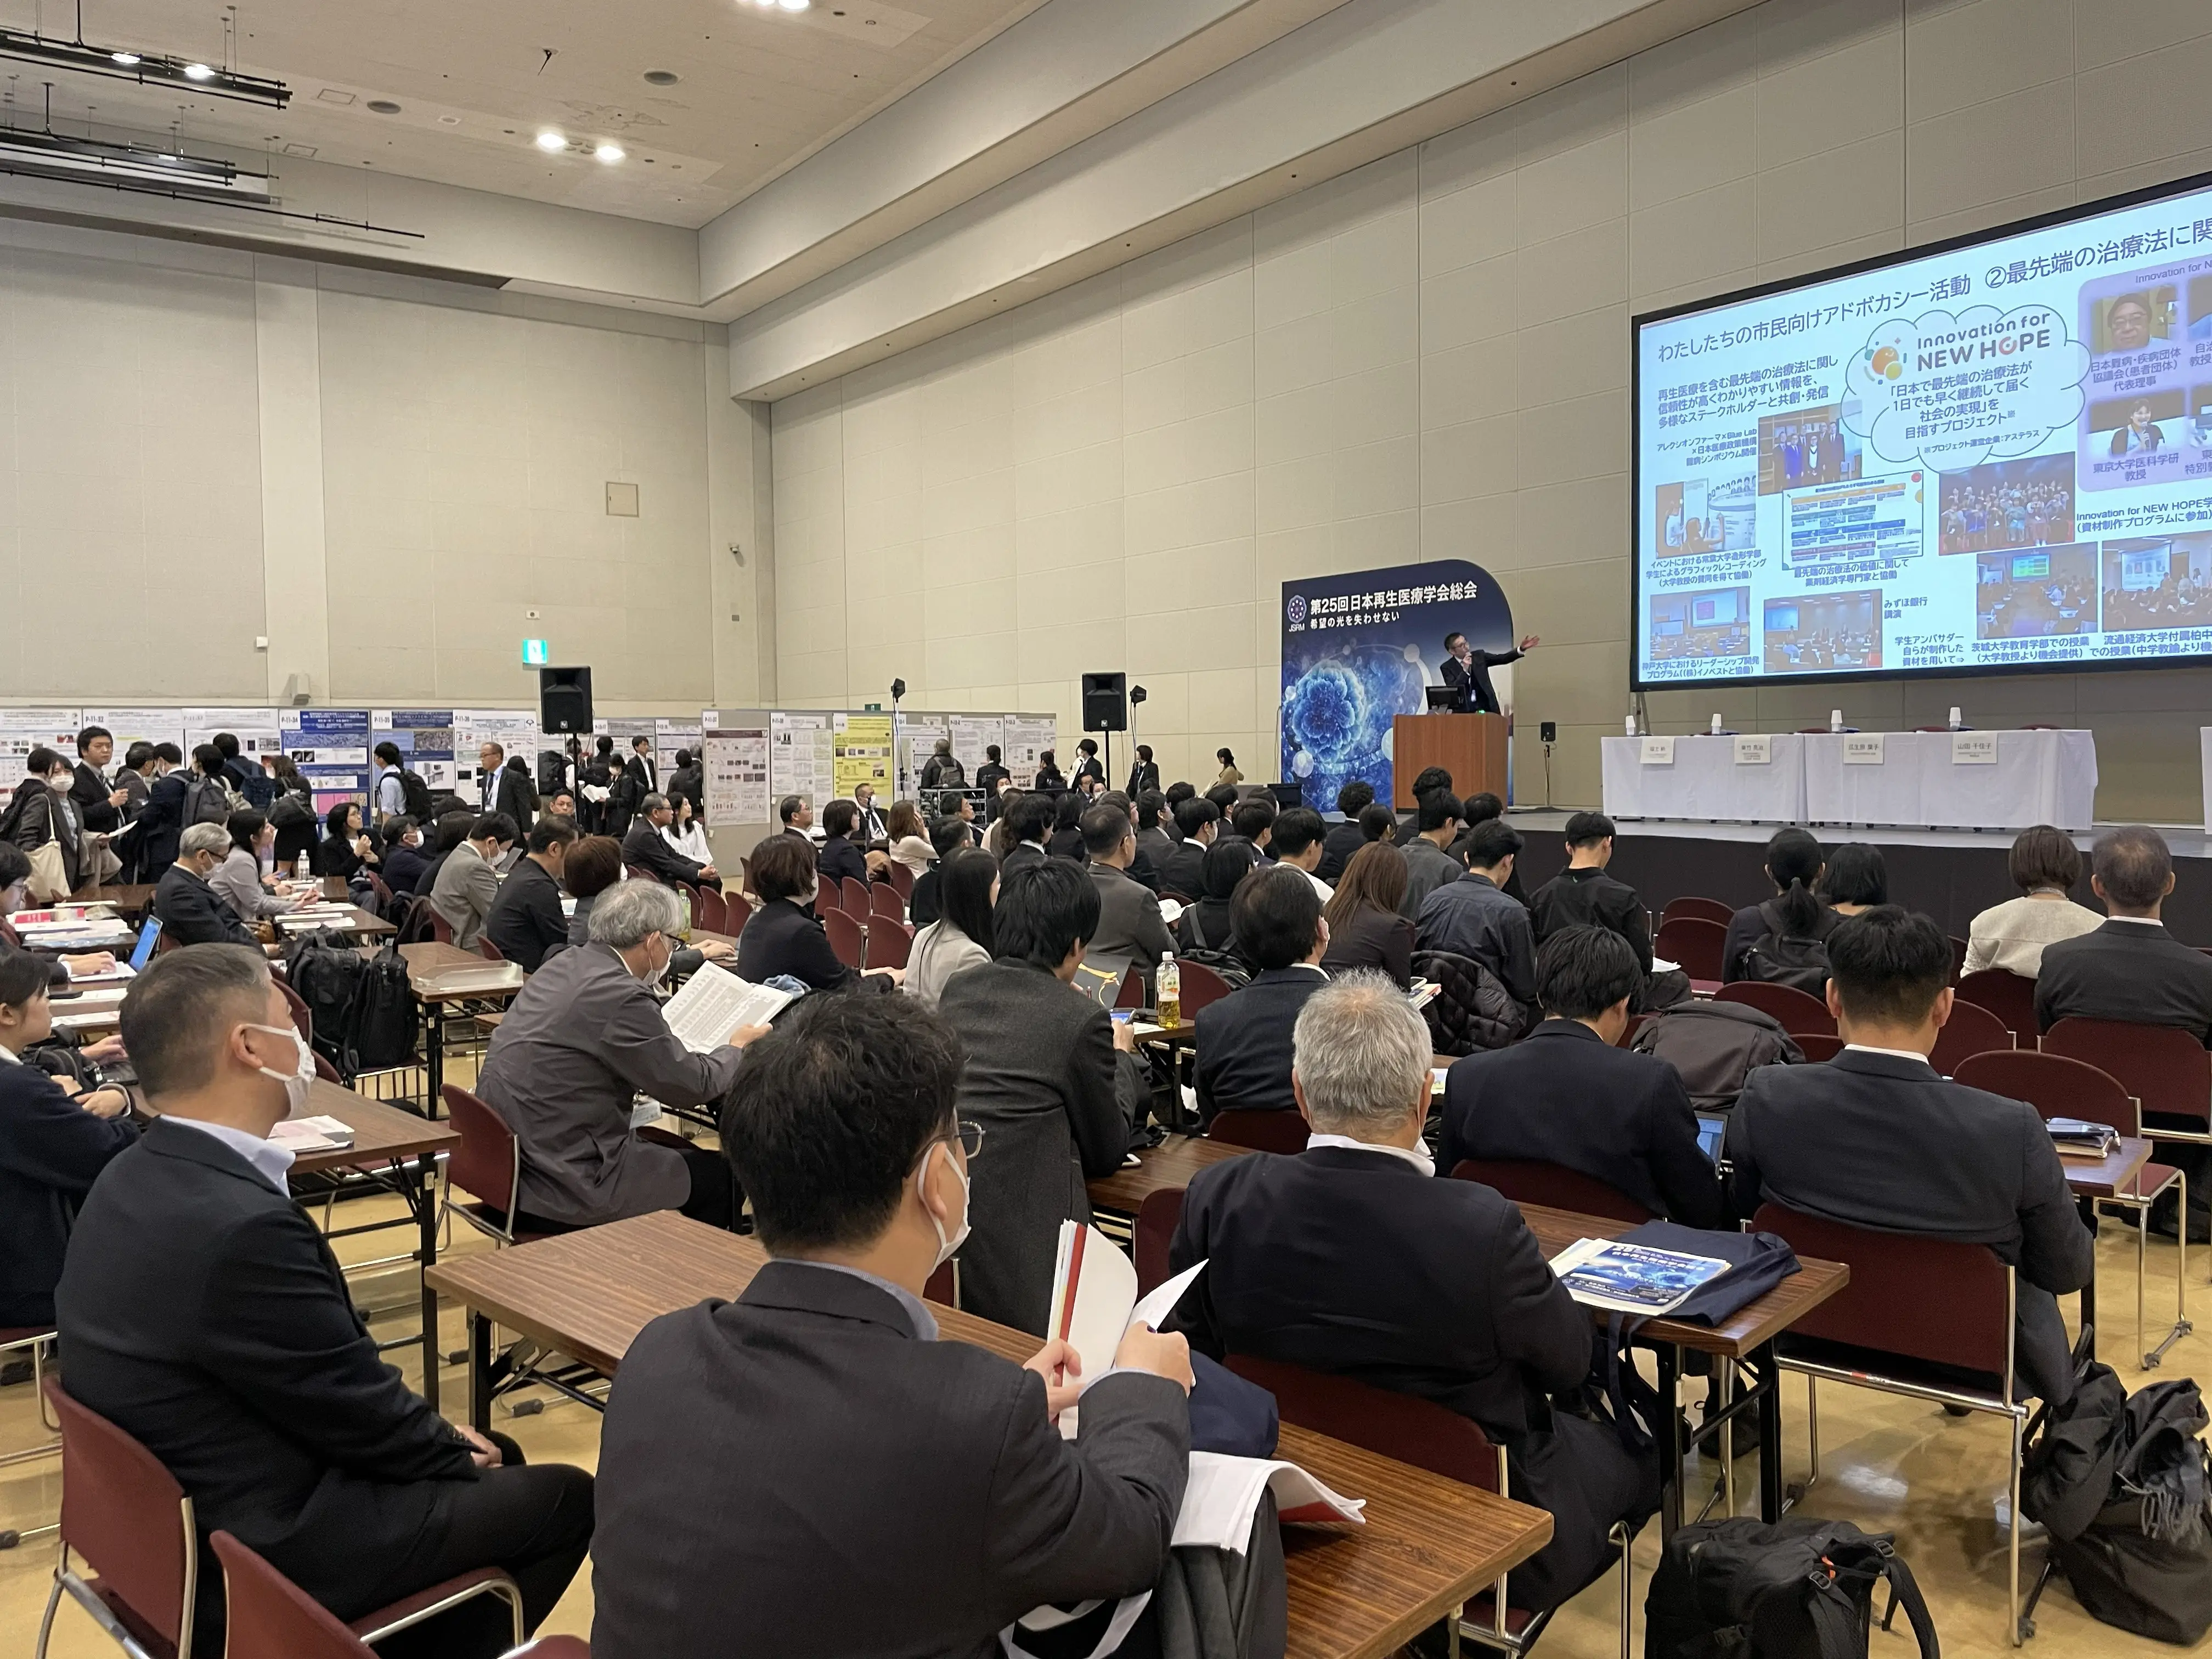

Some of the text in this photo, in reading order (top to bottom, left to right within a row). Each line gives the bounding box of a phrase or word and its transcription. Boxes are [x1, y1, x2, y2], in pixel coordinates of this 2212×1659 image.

[2136, 267, 2185, 283] Innovation
[2188, 263, 2202, 272] for
[1658, 273, 1971, 363] わたしたちの市民向けアドボカシー活動
[1917, 313, 2051, 349] Innovation for
[1917, 329, 2051, 371] NEW HOPE
[1658, 355, 1838, 401] 再生医療を含む最先端の治療法に関し
[1658, 374, 1818, 415] 信頼性が高くわかりやすい情報を、
[1891, 360, 2033, 397] 「日本で最先端の治療法が
[1893, 377, 2029, 411] 1日でも早く継続して届く
[1658, 385, 1829, 430] 多様なステークホルダーと共創・発信
[1920, 399, 1999, 422] 社会の実現」を
[2093, 452, 2180, 473] 東京大学医科学研
[2124, 469, 2147, 482] 教授
[2076, 509, 2125, 521] Innovation
[2128, 507, 2141, 515] for
[2143, 503, 2169, 514] NEW
[1310, 580, 1478, 615] 第25回日本再生医療学会総会
[1884, 596, 1928, 608] みずほ銀行
[1289, 623, 1305, 632] JSRM
[1310, 611, 1400, 630] 希望の光を失わせない
